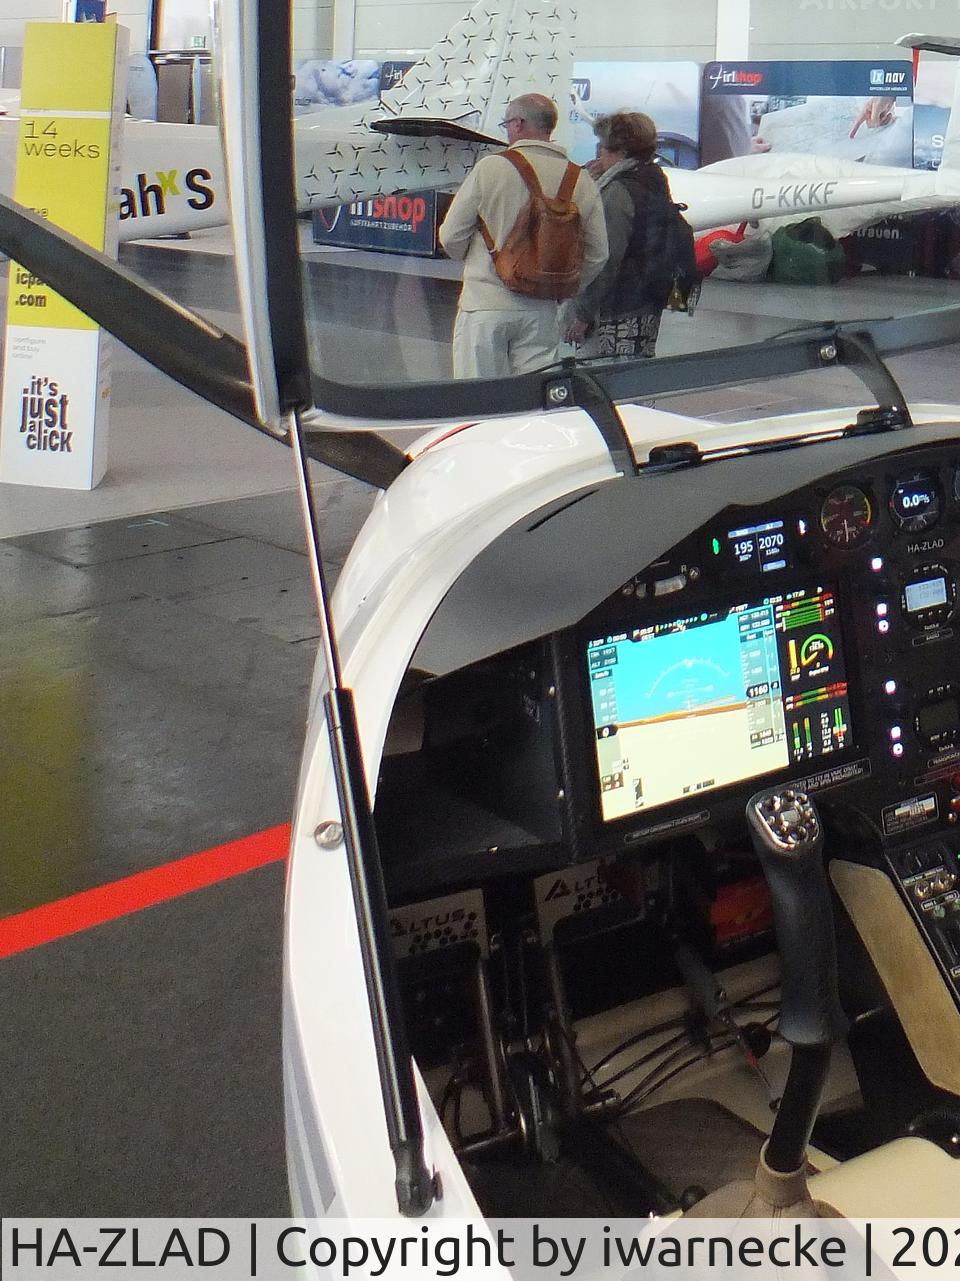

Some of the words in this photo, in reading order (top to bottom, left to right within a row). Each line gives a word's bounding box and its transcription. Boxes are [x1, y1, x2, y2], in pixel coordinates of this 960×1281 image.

[24, 121, 58, 139] 14
[24, 139, 100, 159] weeks
[15, 292, 47, 308] .com
[31, 376, 59, 396] it's
[20, 388, 70, 432] just
[734, 540, 754, 556] 195
[758, 533, 784, 550] 2070
[907, 539, 945, 554] HA-ZLAD
[545, 879, 605, 903] ALT
